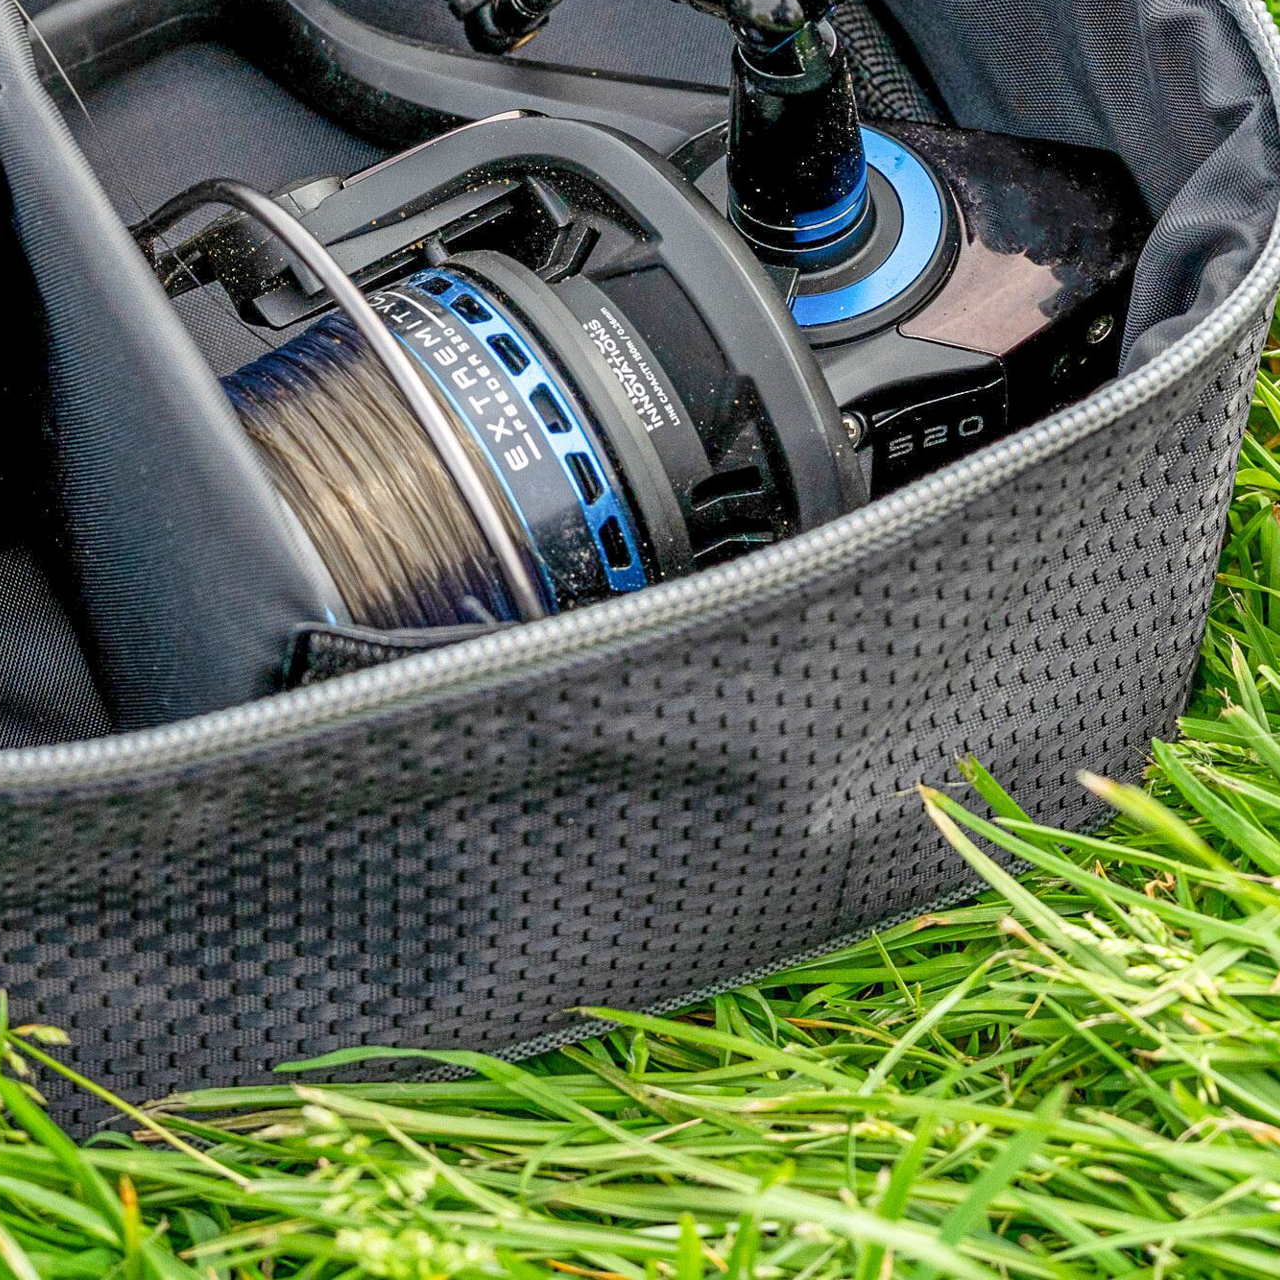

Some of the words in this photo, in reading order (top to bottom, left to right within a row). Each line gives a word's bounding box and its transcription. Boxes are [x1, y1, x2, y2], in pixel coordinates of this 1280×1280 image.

[600, 307, 625, 335] 0.26mm
[443, 327, 470, 353] 520
[626, 340, 642, 361] 150m
[588, 319, 664, 428] INNOVATIONS
[638, 362, 668, 403] CAPACITY
[468, 354, 527, 431] FEEDER
[664, 403, 681, 426] LINE
[888, 415, 984, 459] 520
